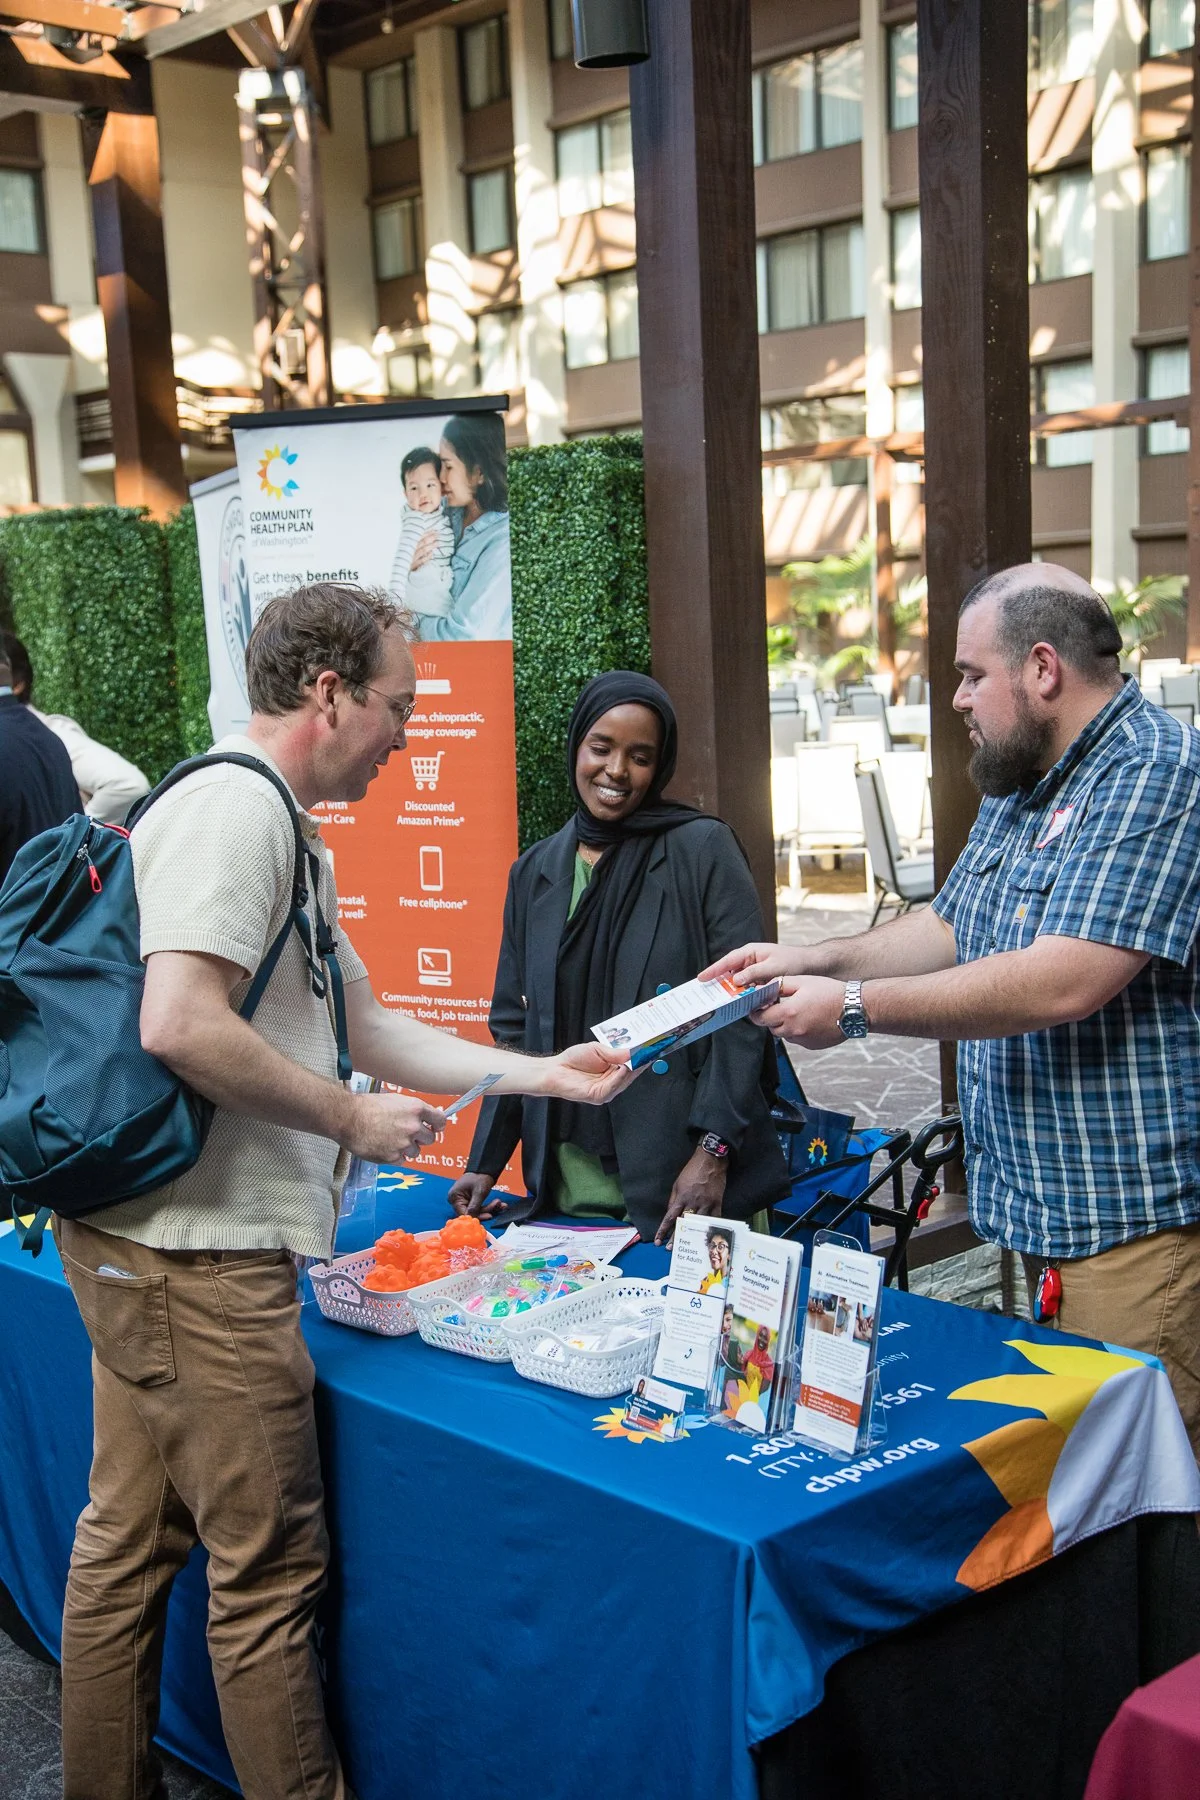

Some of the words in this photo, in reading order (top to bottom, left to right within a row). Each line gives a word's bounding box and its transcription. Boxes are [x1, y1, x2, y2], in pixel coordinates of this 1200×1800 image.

[250, 509, 312, 522] COMMUNITY
[251, 523, 285, 534] HEALTH
[288, 521, 314, 533] PLAN
[253, 571, 270, 584] Get
[272, 569, 303, 583] these
[306, 568, 359, 581] benefits
[429, 712, 485, 724] chiropractic,
[435, 728, 477, 740] coverage
[326, 801, 348, 810] with
[405, 801, 455, 813] Discounted
[333, 814, 356, 825] Care
[396, 815, 432, 826] Amazon
[399, 896, 418, 907] Free
[381, 991, 433, 1006] Community
[434, 997, 477, 1007] resources
[417, 1008, 440, 1020] food,
[441, 1010, 456, 1022] job
[457, 1012, 490, 1022] trainin
[415, 1155, 439, 1165] a.m.
[441, 1156, 454, 1167] to
[678, 1245, 698, 1255] Glasses
[686, 1254, 703, 1264] Adults
[878, 1321, 911, 1336] LAN
[877, 1351, 909, 1367] unity
[805, 1437, 940, 1493] chpw.org
